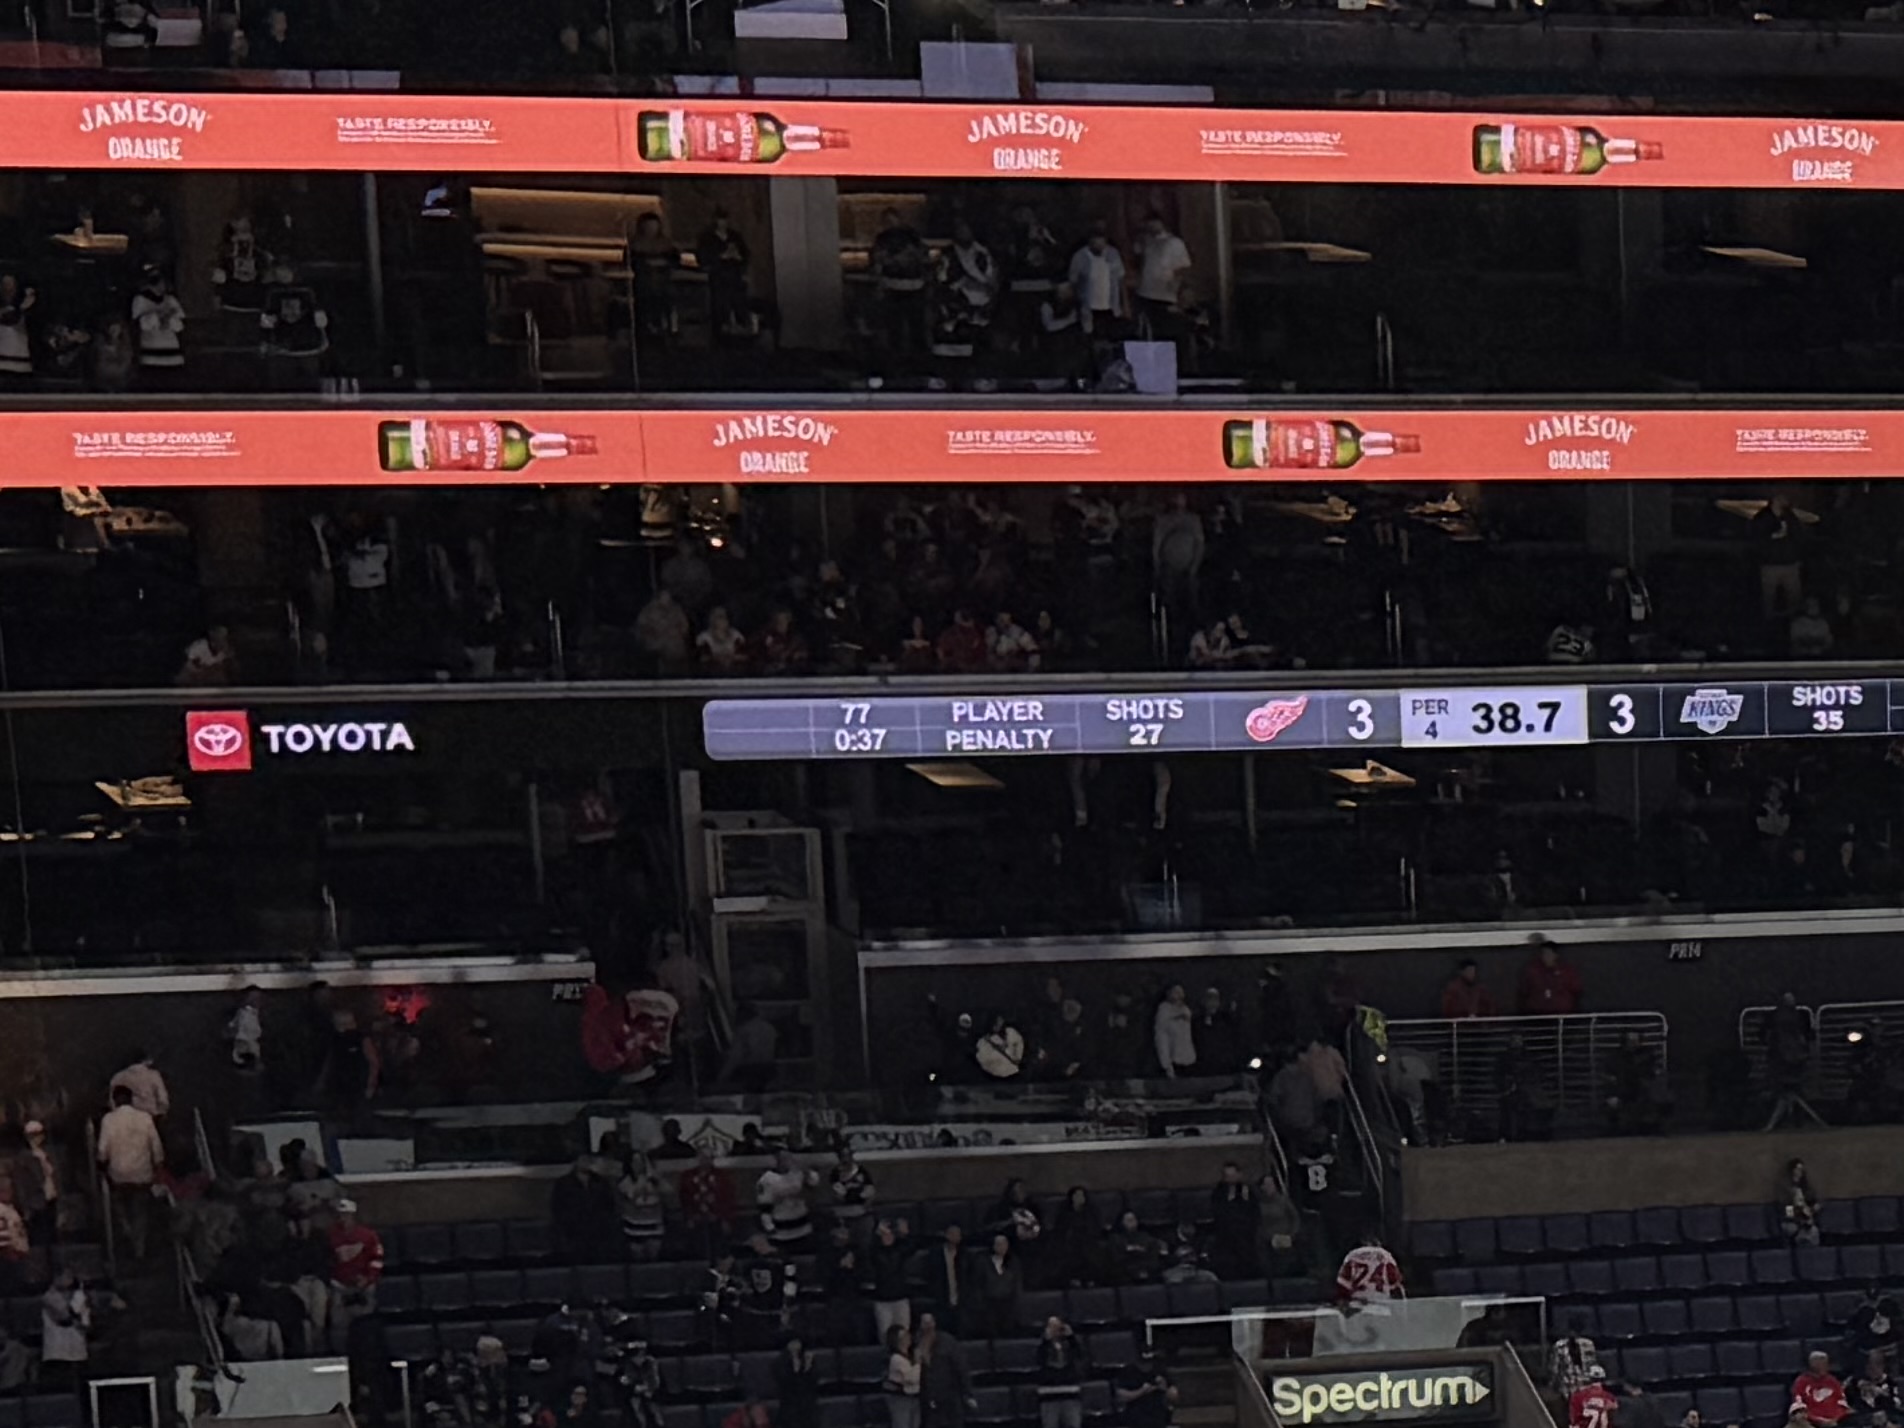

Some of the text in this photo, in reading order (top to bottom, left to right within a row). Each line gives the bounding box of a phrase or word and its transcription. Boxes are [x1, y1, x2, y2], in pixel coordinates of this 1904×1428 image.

[79, 100, 208, 132] JAMESON
[967, 112, 1084, 142] JAMESON
[108, 137, 183, 161] ORANGE
[1770, 125, 1876, 156] JAMESON
[713, 413, 832, 447] JAMESON
[1524, 414, 1634, 447] JAMESON
[1410, 697, 1451, 718] PER
[1687, 699, 1736, 718] KINGS
[1791, 685, 1864, 708] SHOTS
[840, 703, 870, 725] 77
[952, 699, 1043, 724] PLAYER
[1105, 698, 1183, 722] SHOTS
[1347, 699, 1375, 741] 3
[1471, 701, 1562, 736] 38.7
[1609, 693, 1635, 735] 3
[1813, 711, 1844, 732] 35
[261, 721, 415, 753] TOYOTA
[834, 728, 887, 752] 0:37
[946, 728, 1053, 752] PENALTY
[1129, 723, 1163, 746] 27
[1424, 719, 1439, 741] 4
[1271, 1374, 1474, 1424] Spectrum
